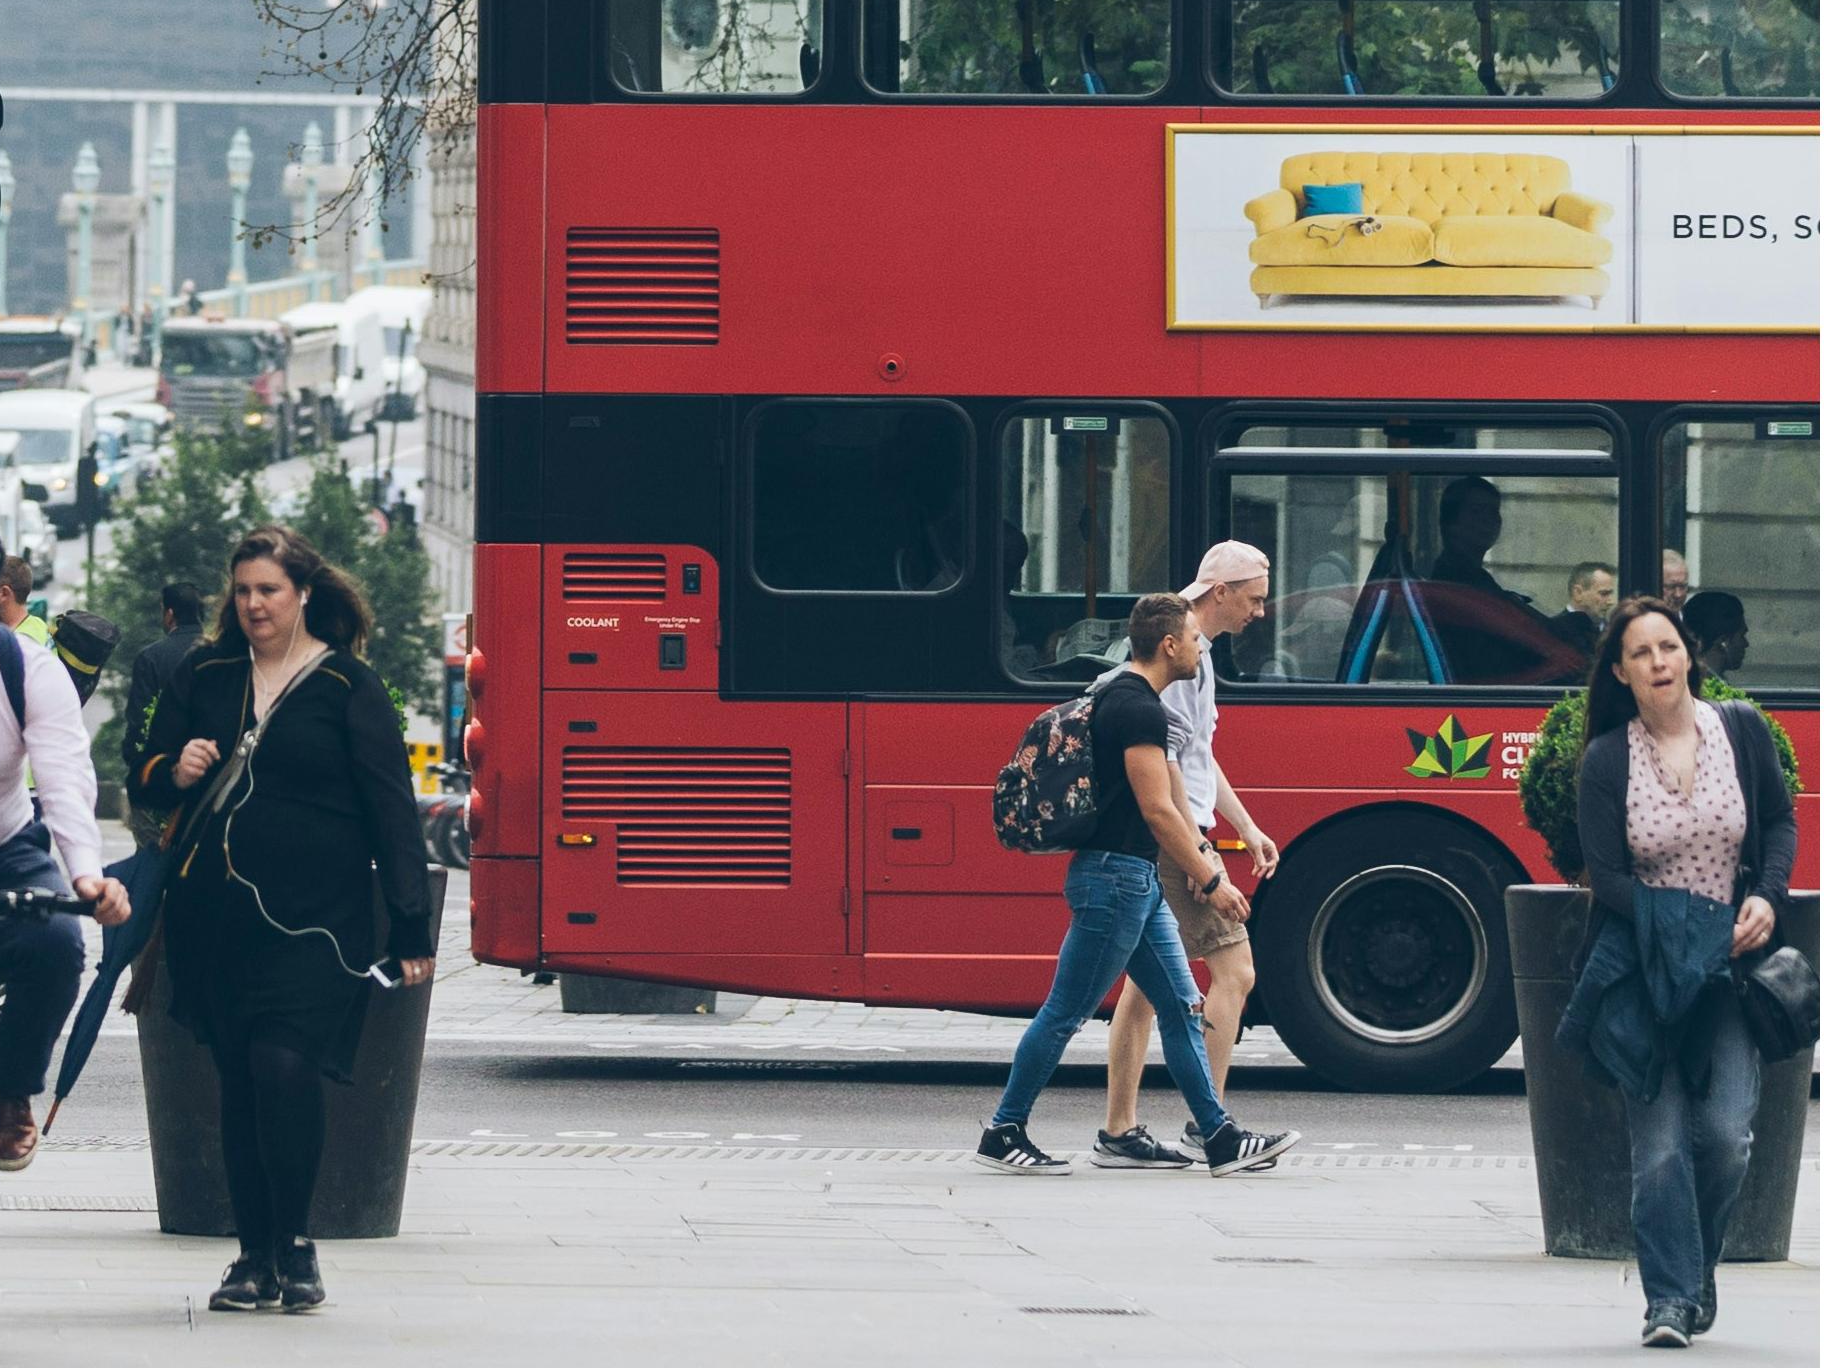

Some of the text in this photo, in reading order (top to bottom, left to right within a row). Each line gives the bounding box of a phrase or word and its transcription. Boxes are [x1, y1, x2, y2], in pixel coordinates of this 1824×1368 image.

[1673, 214, 1821, 244] BEDS, S
[566, 617, 619, 628] COOLANT
